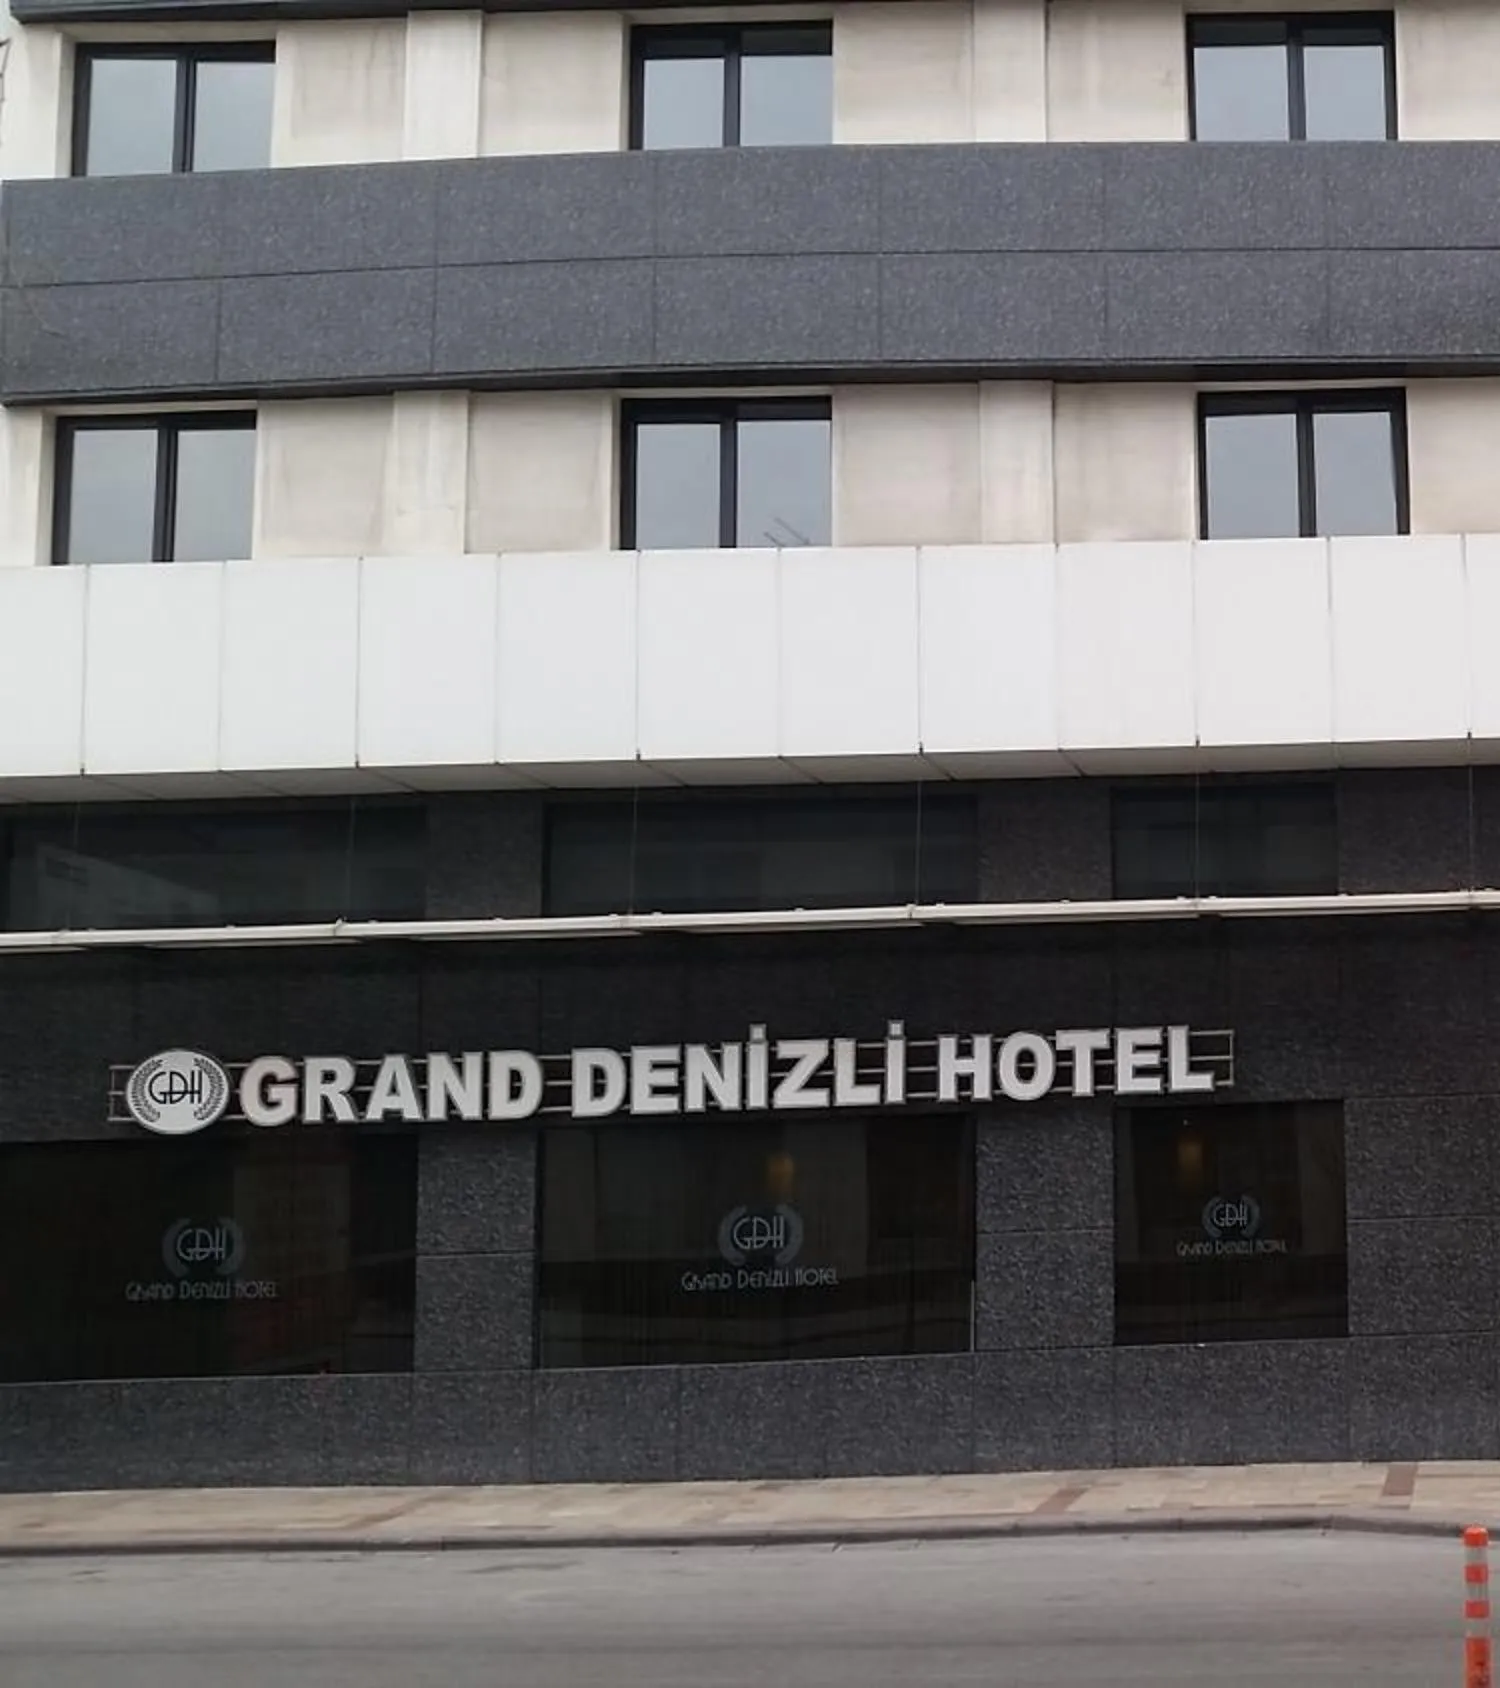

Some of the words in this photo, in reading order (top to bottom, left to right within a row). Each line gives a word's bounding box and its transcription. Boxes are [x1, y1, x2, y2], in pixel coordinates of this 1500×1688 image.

[240, 1048, 543, 1127] GRAND
[571, 1020, 906, 1119] DENİZLİ
[936, 1024, 1215, 1102] HOTEL
[176, 1227, 227, 1261] GDH
[733, 1215, 785, 1249] GDH
